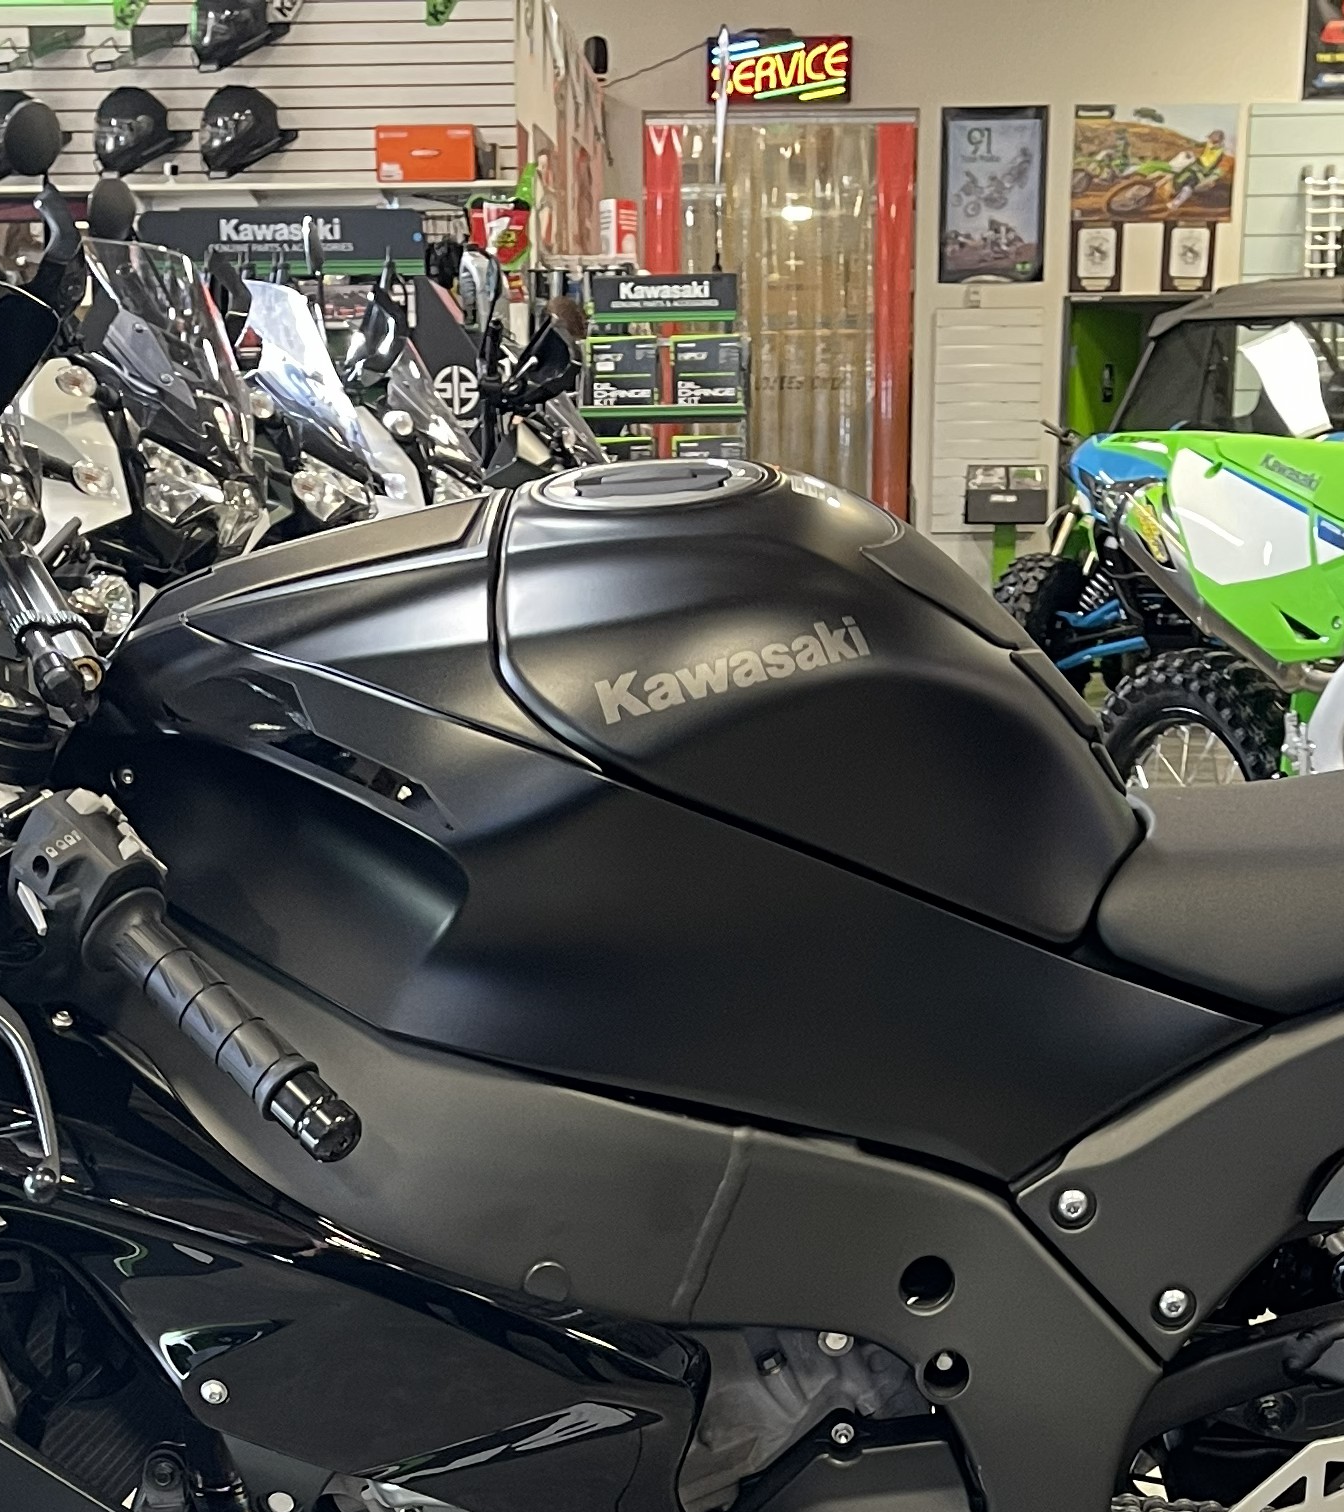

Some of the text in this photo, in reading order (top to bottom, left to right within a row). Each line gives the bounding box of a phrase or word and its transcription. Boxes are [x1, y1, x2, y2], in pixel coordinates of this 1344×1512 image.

[218, 216, 342, 242] Kawaski
[619, 280, 711, 300] Kawasaki
[594, 615, 870, 725] Kawasaki
